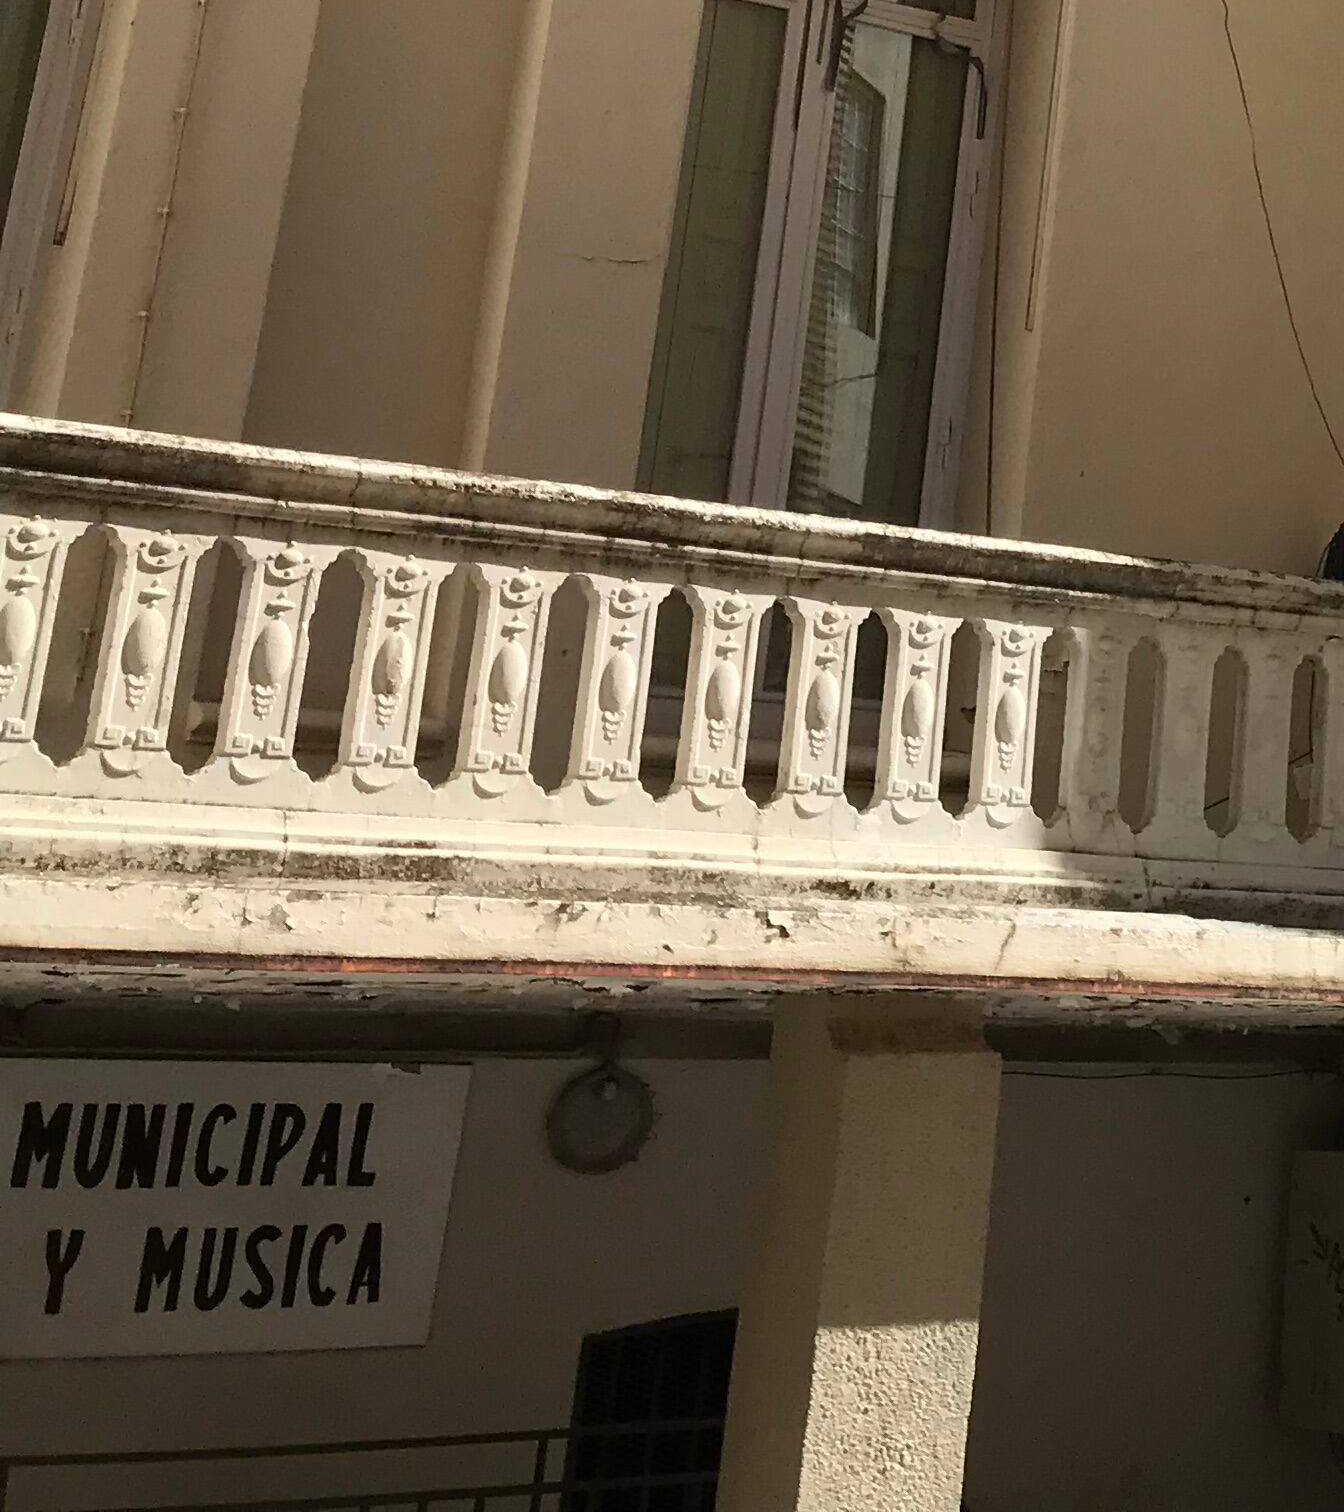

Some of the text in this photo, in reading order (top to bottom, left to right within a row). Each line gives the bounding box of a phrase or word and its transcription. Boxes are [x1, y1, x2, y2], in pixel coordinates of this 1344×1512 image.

[10, 1101, 378, 1190] MUNICIPAL
[44, 1222, 384, 1315] Y MUSICA
